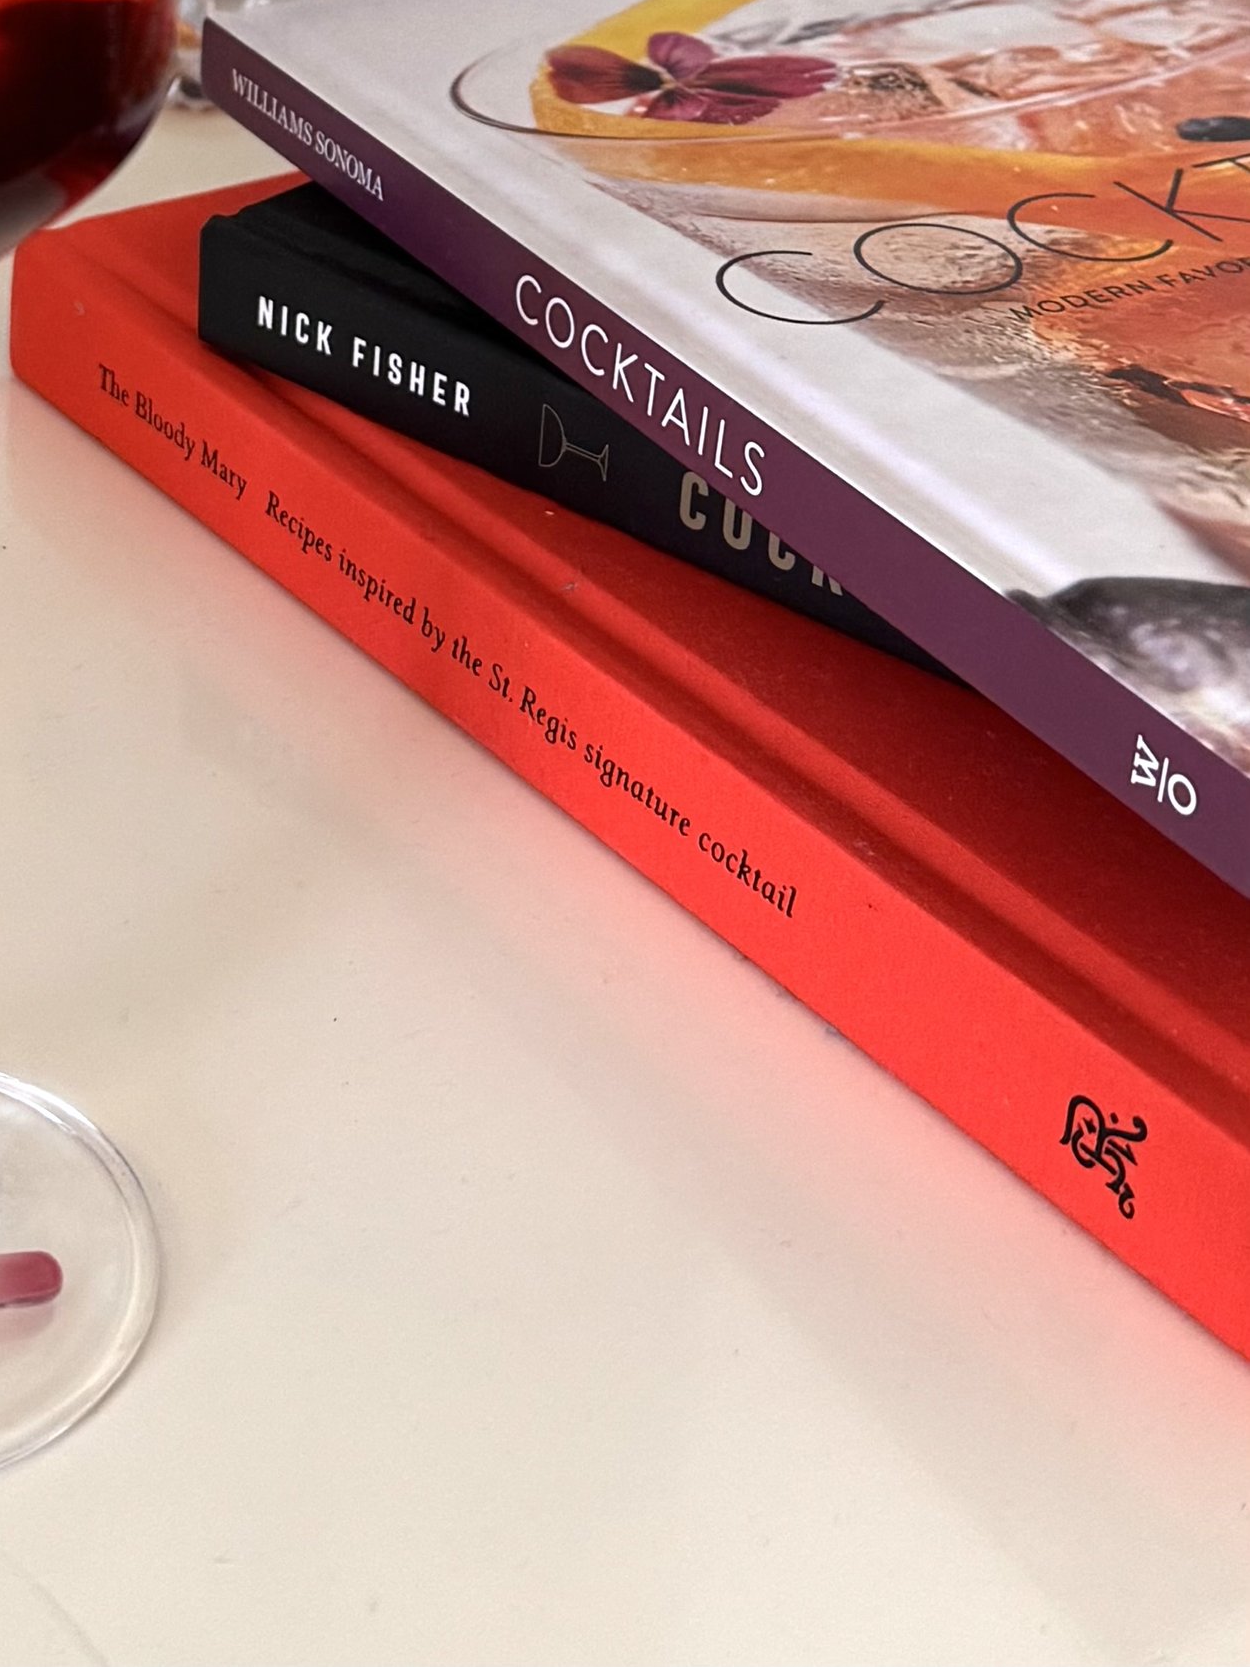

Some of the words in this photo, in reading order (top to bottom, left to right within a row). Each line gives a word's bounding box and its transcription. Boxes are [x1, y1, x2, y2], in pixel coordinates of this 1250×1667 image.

[232, 68, 313, 146] WILLIAMS
[315, 133, 384, 201] SONOMA
[258, 296, 332, 354] NICK
[352, 337, 471, 417] FISHER
[1009, 279, 1156, 321] MODERN
[516, 275, 765, 496] COCKTAILS
[99, 364, 129, 407] The
[135, 391, 196, 461] Bloody
[201, 441, 248, 501] Mary
[265, 490, 333, 561] Recipes
[340, 548, 417, 625] inspired
[421, 607, 446, 653] by
[452, 636, 482, 676] the
[488, 664, 514, 703] St.
[519, 686, 578, 751] Regis
[583, 744, 692, 837] signature
[698, 832, 798, 917] cocktail
